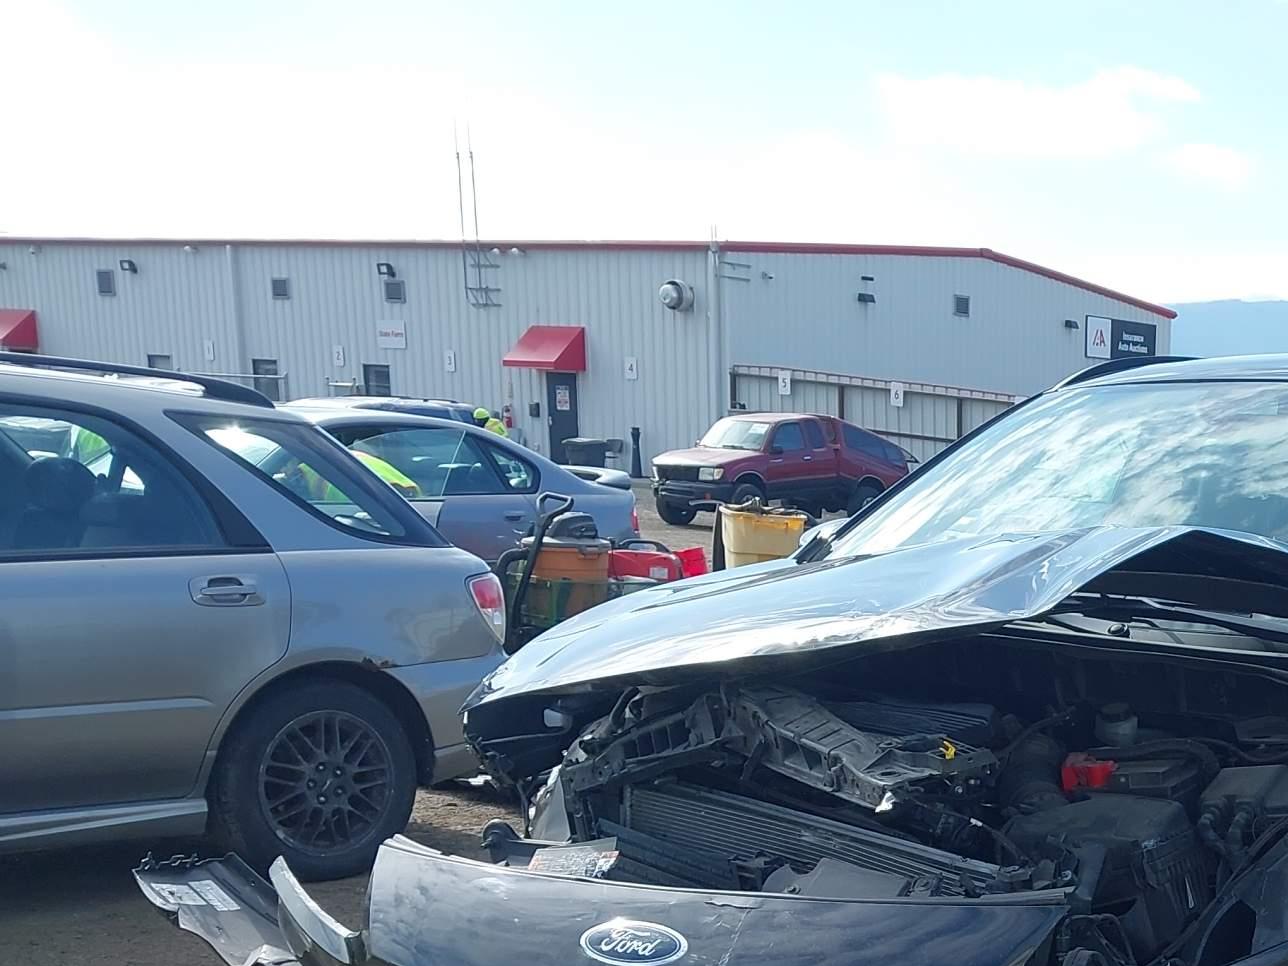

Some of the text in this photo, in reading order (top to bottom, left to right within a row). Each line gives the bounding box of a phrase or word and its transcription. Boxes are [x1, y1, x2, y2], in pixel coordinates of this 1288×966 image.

[1117, 341, 1129, 351] Auto
[628, 363, 634, 372] 4
[782, 378, 788, 388] 5
[894, 390, 900, 400] 6
[600, 927, 662, 956] Ford
